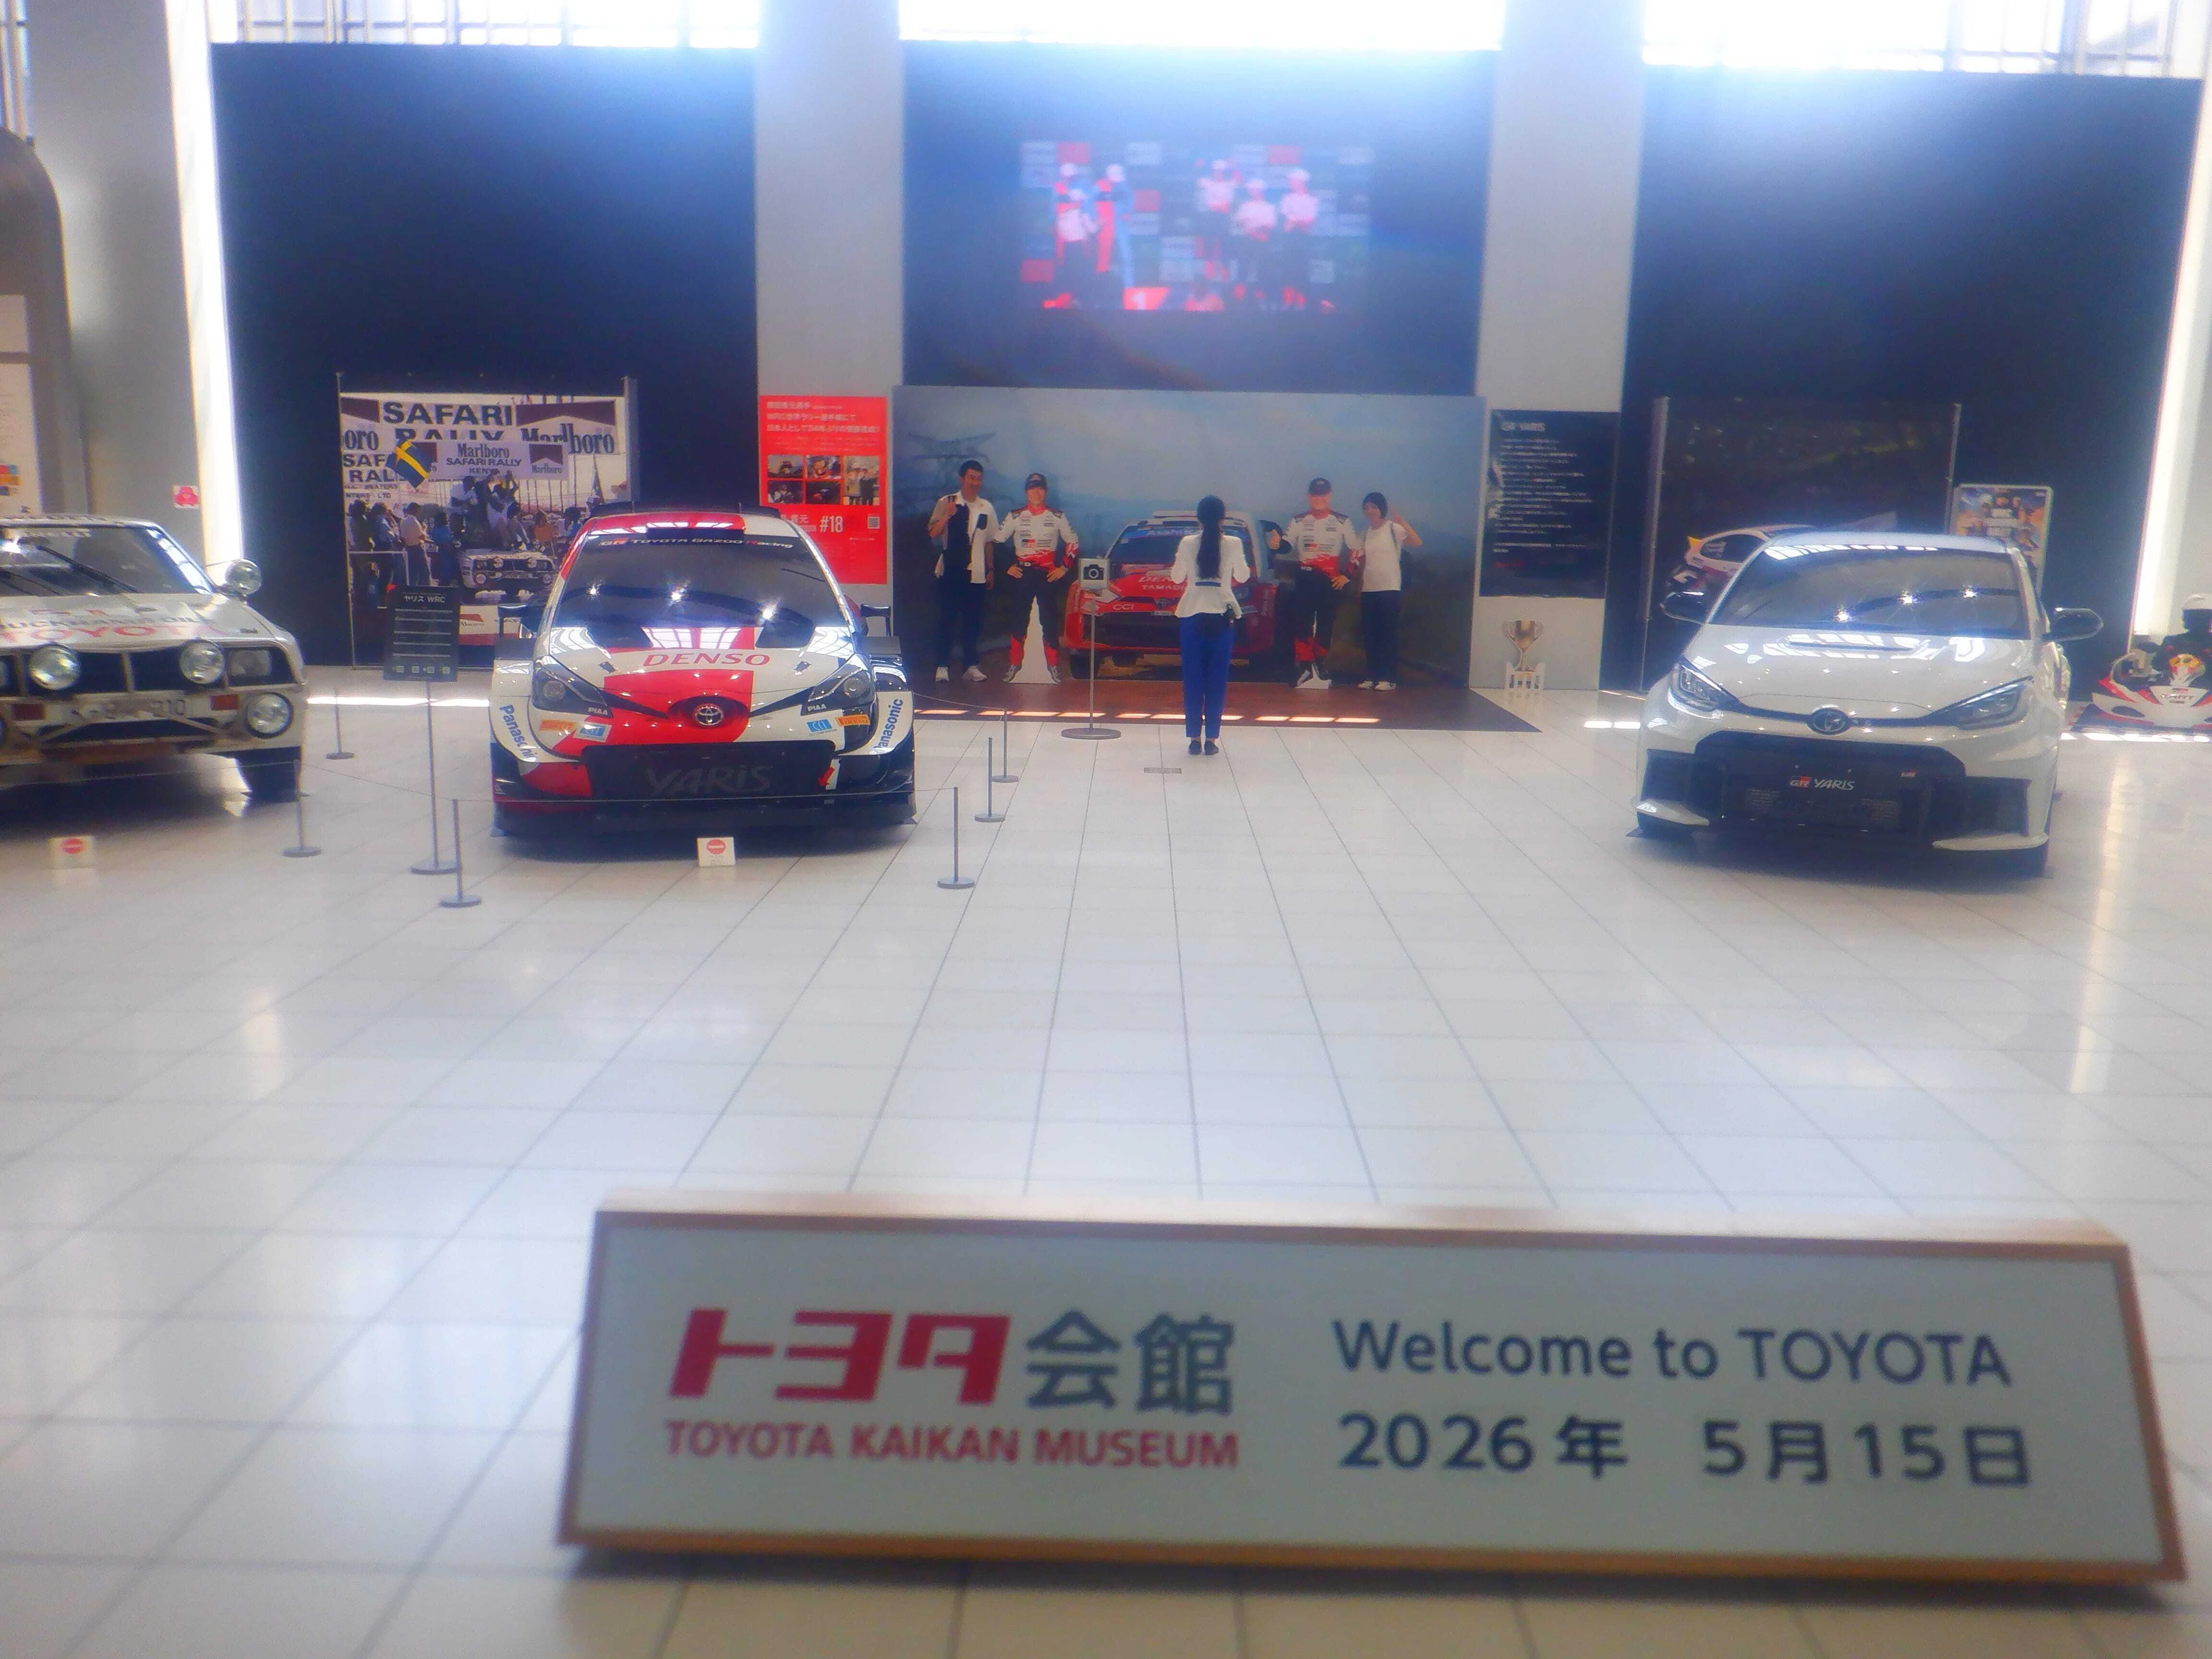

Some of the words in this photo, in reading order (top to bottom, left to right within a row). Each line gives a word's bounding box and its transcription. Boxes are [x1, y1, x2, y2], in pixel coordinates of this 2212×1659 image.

[383, 401, 512, 426] SAFARI
[457, 443, 510, 458] Marlboro
[343, 454, 386, 468] SAF
[488, 458, 522, 467] RALLY
[349, 469, 408, 482] RAL
[532, 463, 563, 474] Marlboro
[820, 515, 843, 533] #18
[745, 540, 793, 549] Racing
[643, 653, 770, 667] DENSO
[588, 707, 608, 715] PIAA
[807, 703, 827, 712] PIAA
[499, 704, 538, 760] Panasoni
[645, 765, 773, 797] YARIS
[1790, 778, 1811, 788] GR
[1814, 778, 1855, 791] YARIS
[1332, 1319, 1632, 1378] Welcome
[1653, 1327, 1719, 1379] to
[1735, 1327, 2013, 1386] TOYOTA
[669, 1307, 1236, 1416] トヨタ会館
[666, 1419, 834, 1460] TOYOTA
[849, 1424, 1017, 1465] KAIKAN
[1034, 1428, 1241, 1470] MUSEUM
[1338, 1409, 1629, 1479] 2026年
[1702, 1419, 2031, 1486] 5月15日
